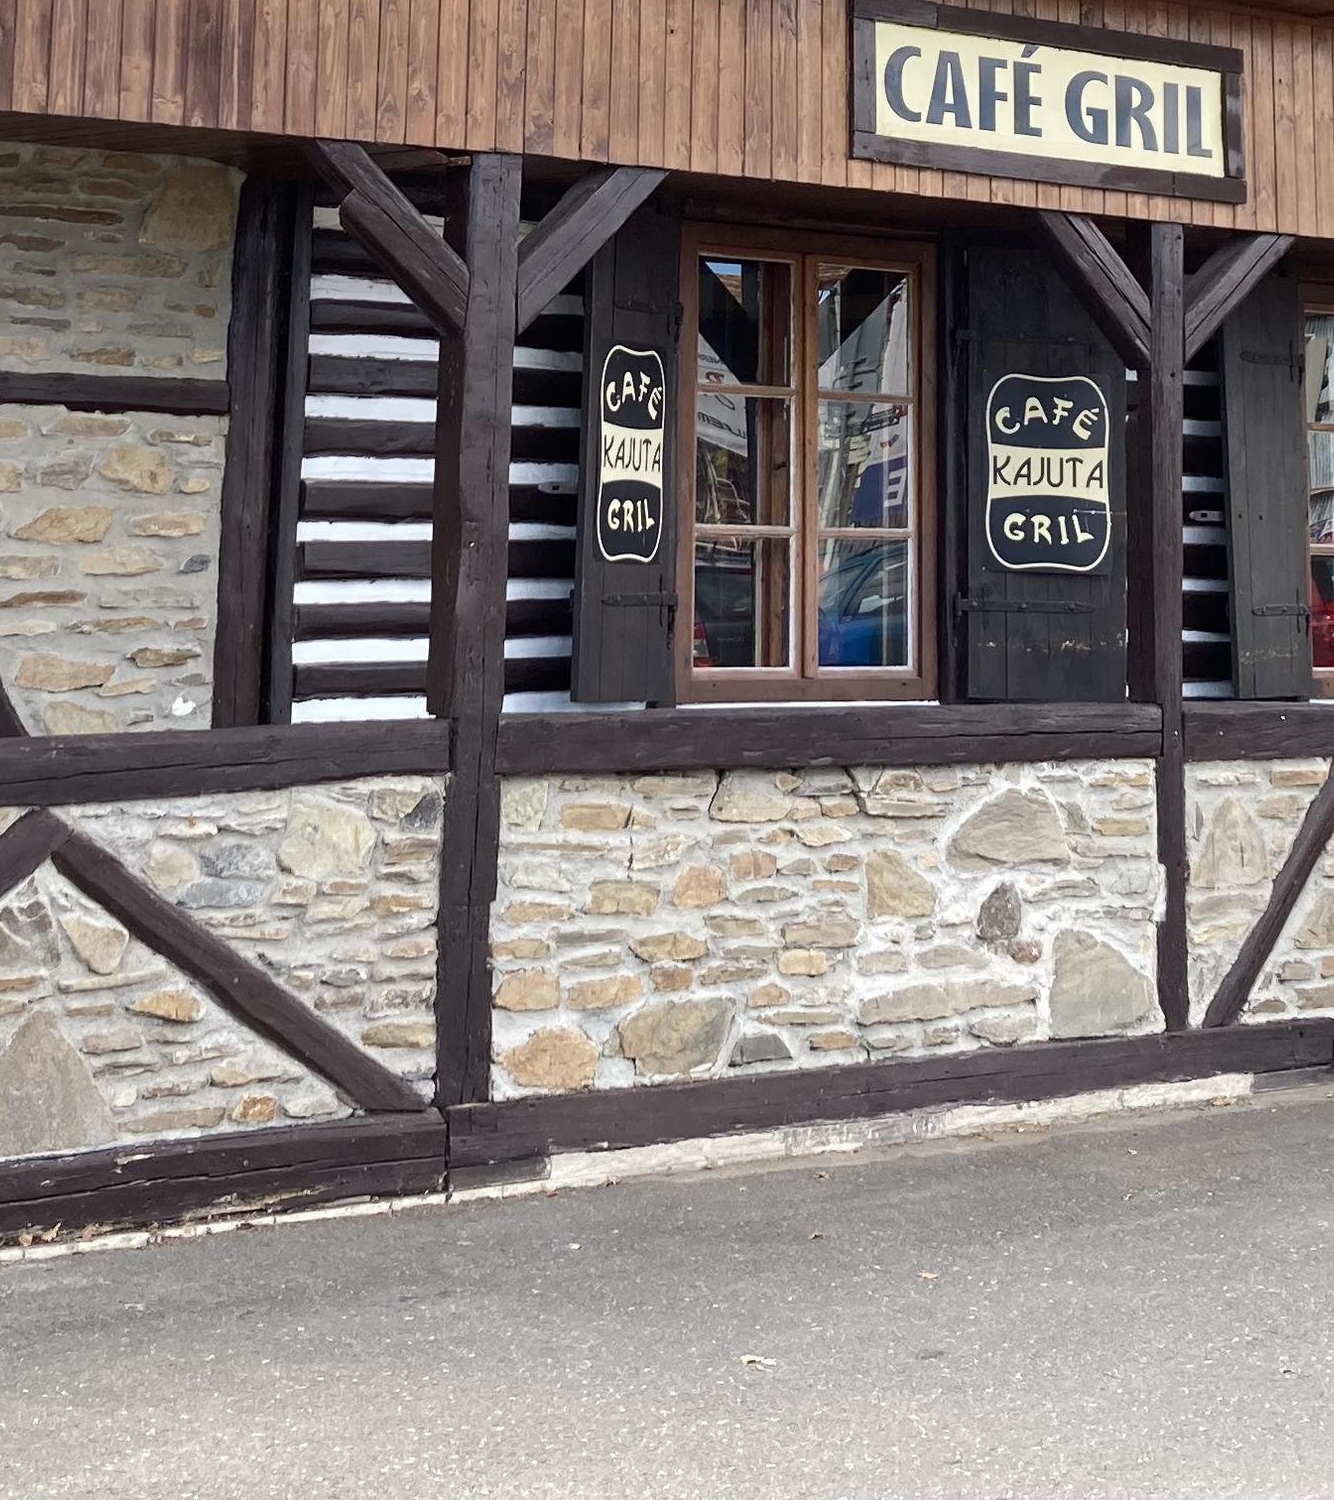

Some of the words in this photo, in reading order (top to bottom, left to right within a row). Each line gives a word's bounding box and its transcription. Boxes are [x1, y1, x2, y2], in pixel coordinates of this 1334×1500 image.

[883, 44, 1043, 138] CAFÉ
[1065, 70, 1213, 159] GRIL
[606, 370, 663, 421] CAFÉ
[995, 396, 1100, 441] CAFÉ
[603, 434, 662, 474] KAJUTA
[992, 454, 1104, 489] KAJUTA
[607, 497, 655, 533] GRIL
[1003, 512, 1095, 546] GRIL
